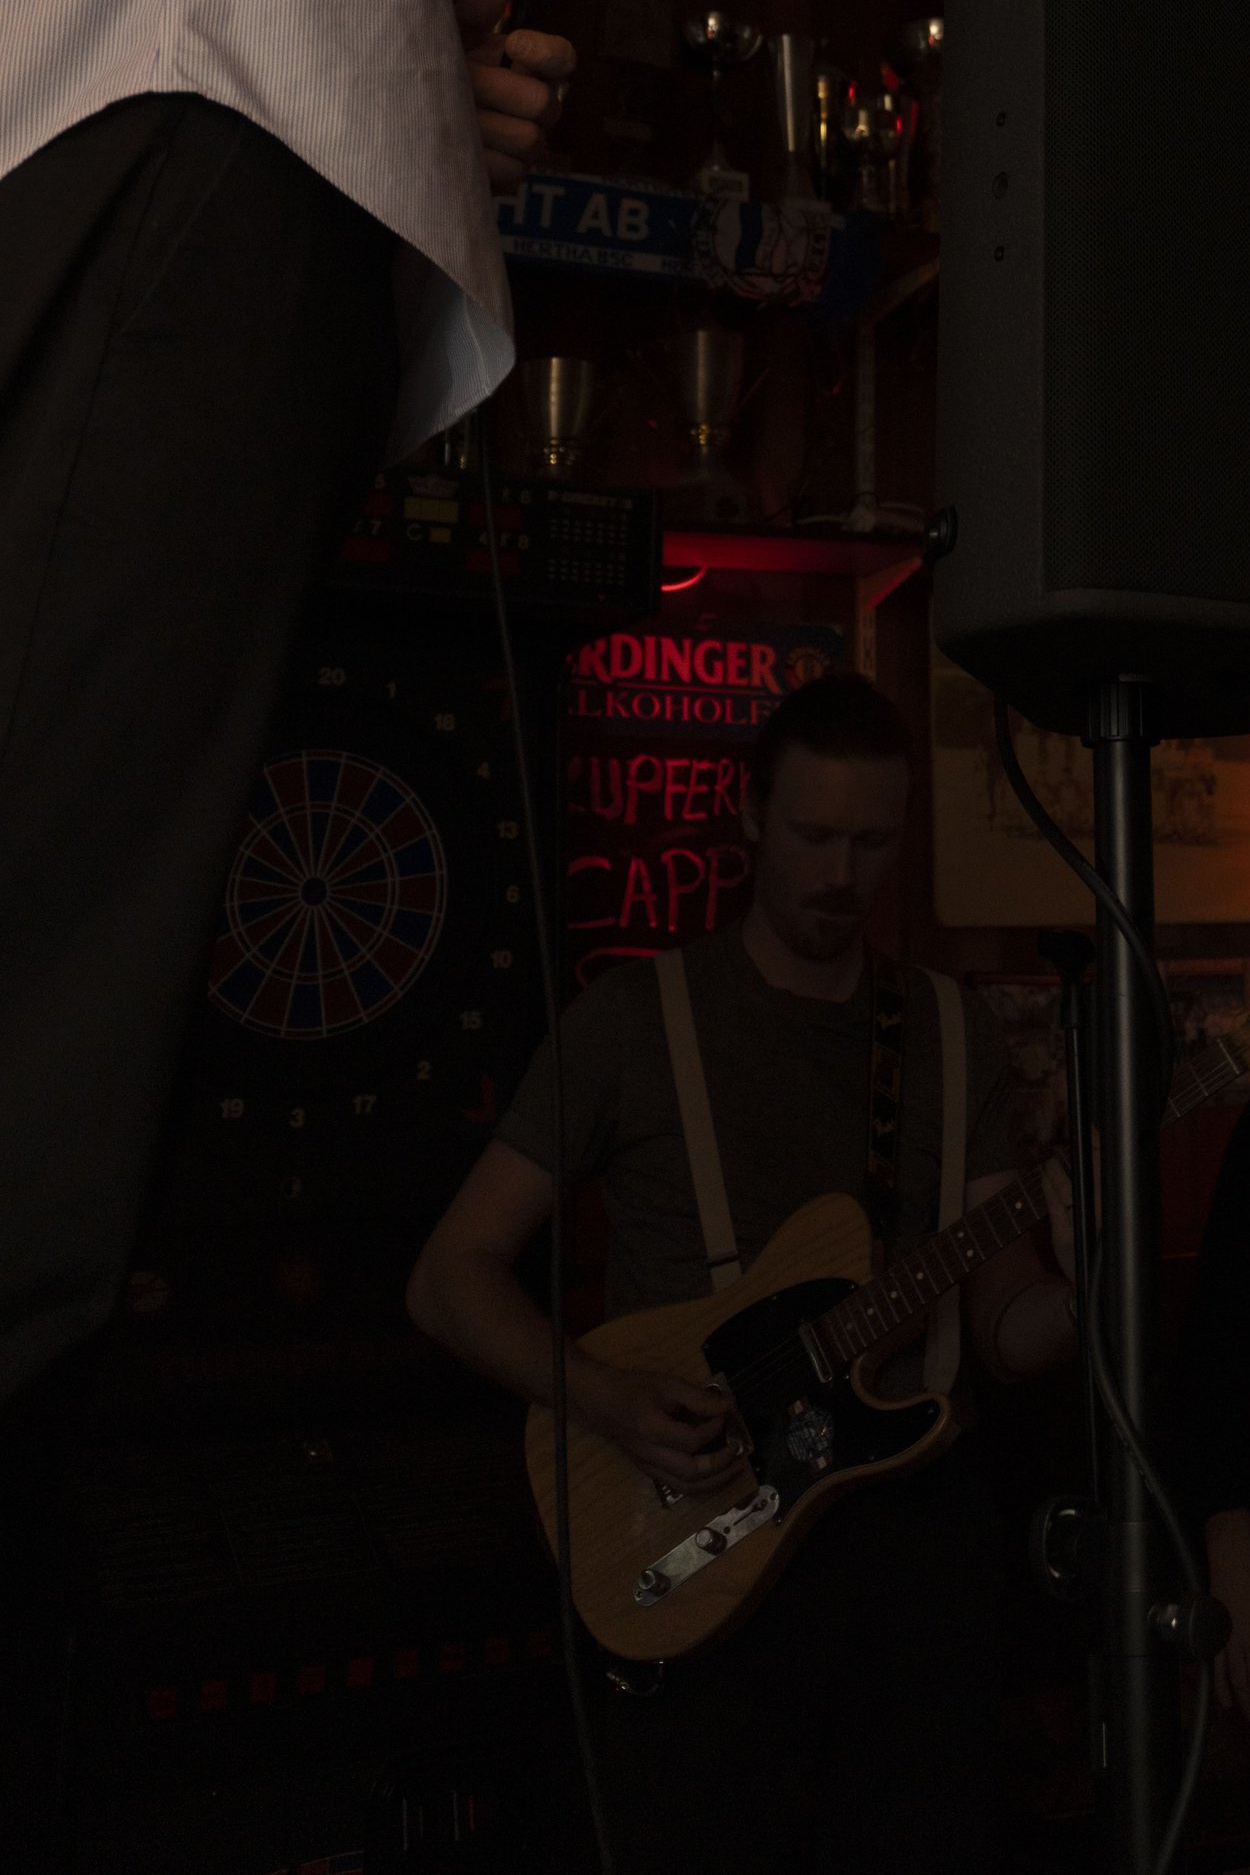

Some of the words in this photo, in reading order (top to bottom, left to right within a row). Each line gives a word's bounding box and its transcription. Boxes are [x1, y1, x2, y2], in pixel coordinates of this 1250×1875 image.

[575, 192, 650, 241] AB
[513, 238, 592, 263] HERTHA
[598, 249, 632, 268] BSC
[566, 633, 782, 695] RDINGER
[317, 668, 347, 686] 20
[568, 689, 780, 726] LKOHOLF
[434, 714, 456, 732] 18
[476, 762, 491, 779] 4
[496, 822, 519, 840] 13
[505, 885, 520, 903] 6
[491, 951, 513, 969] 10
[460, 1011, 482, 1031] 15
[416, 1061, 431, 1081] 2
[219, 1098, 245, 1119] 19
[352, 1095, 376, 1115] 17
[289, 1109, 305, 1127] 3
